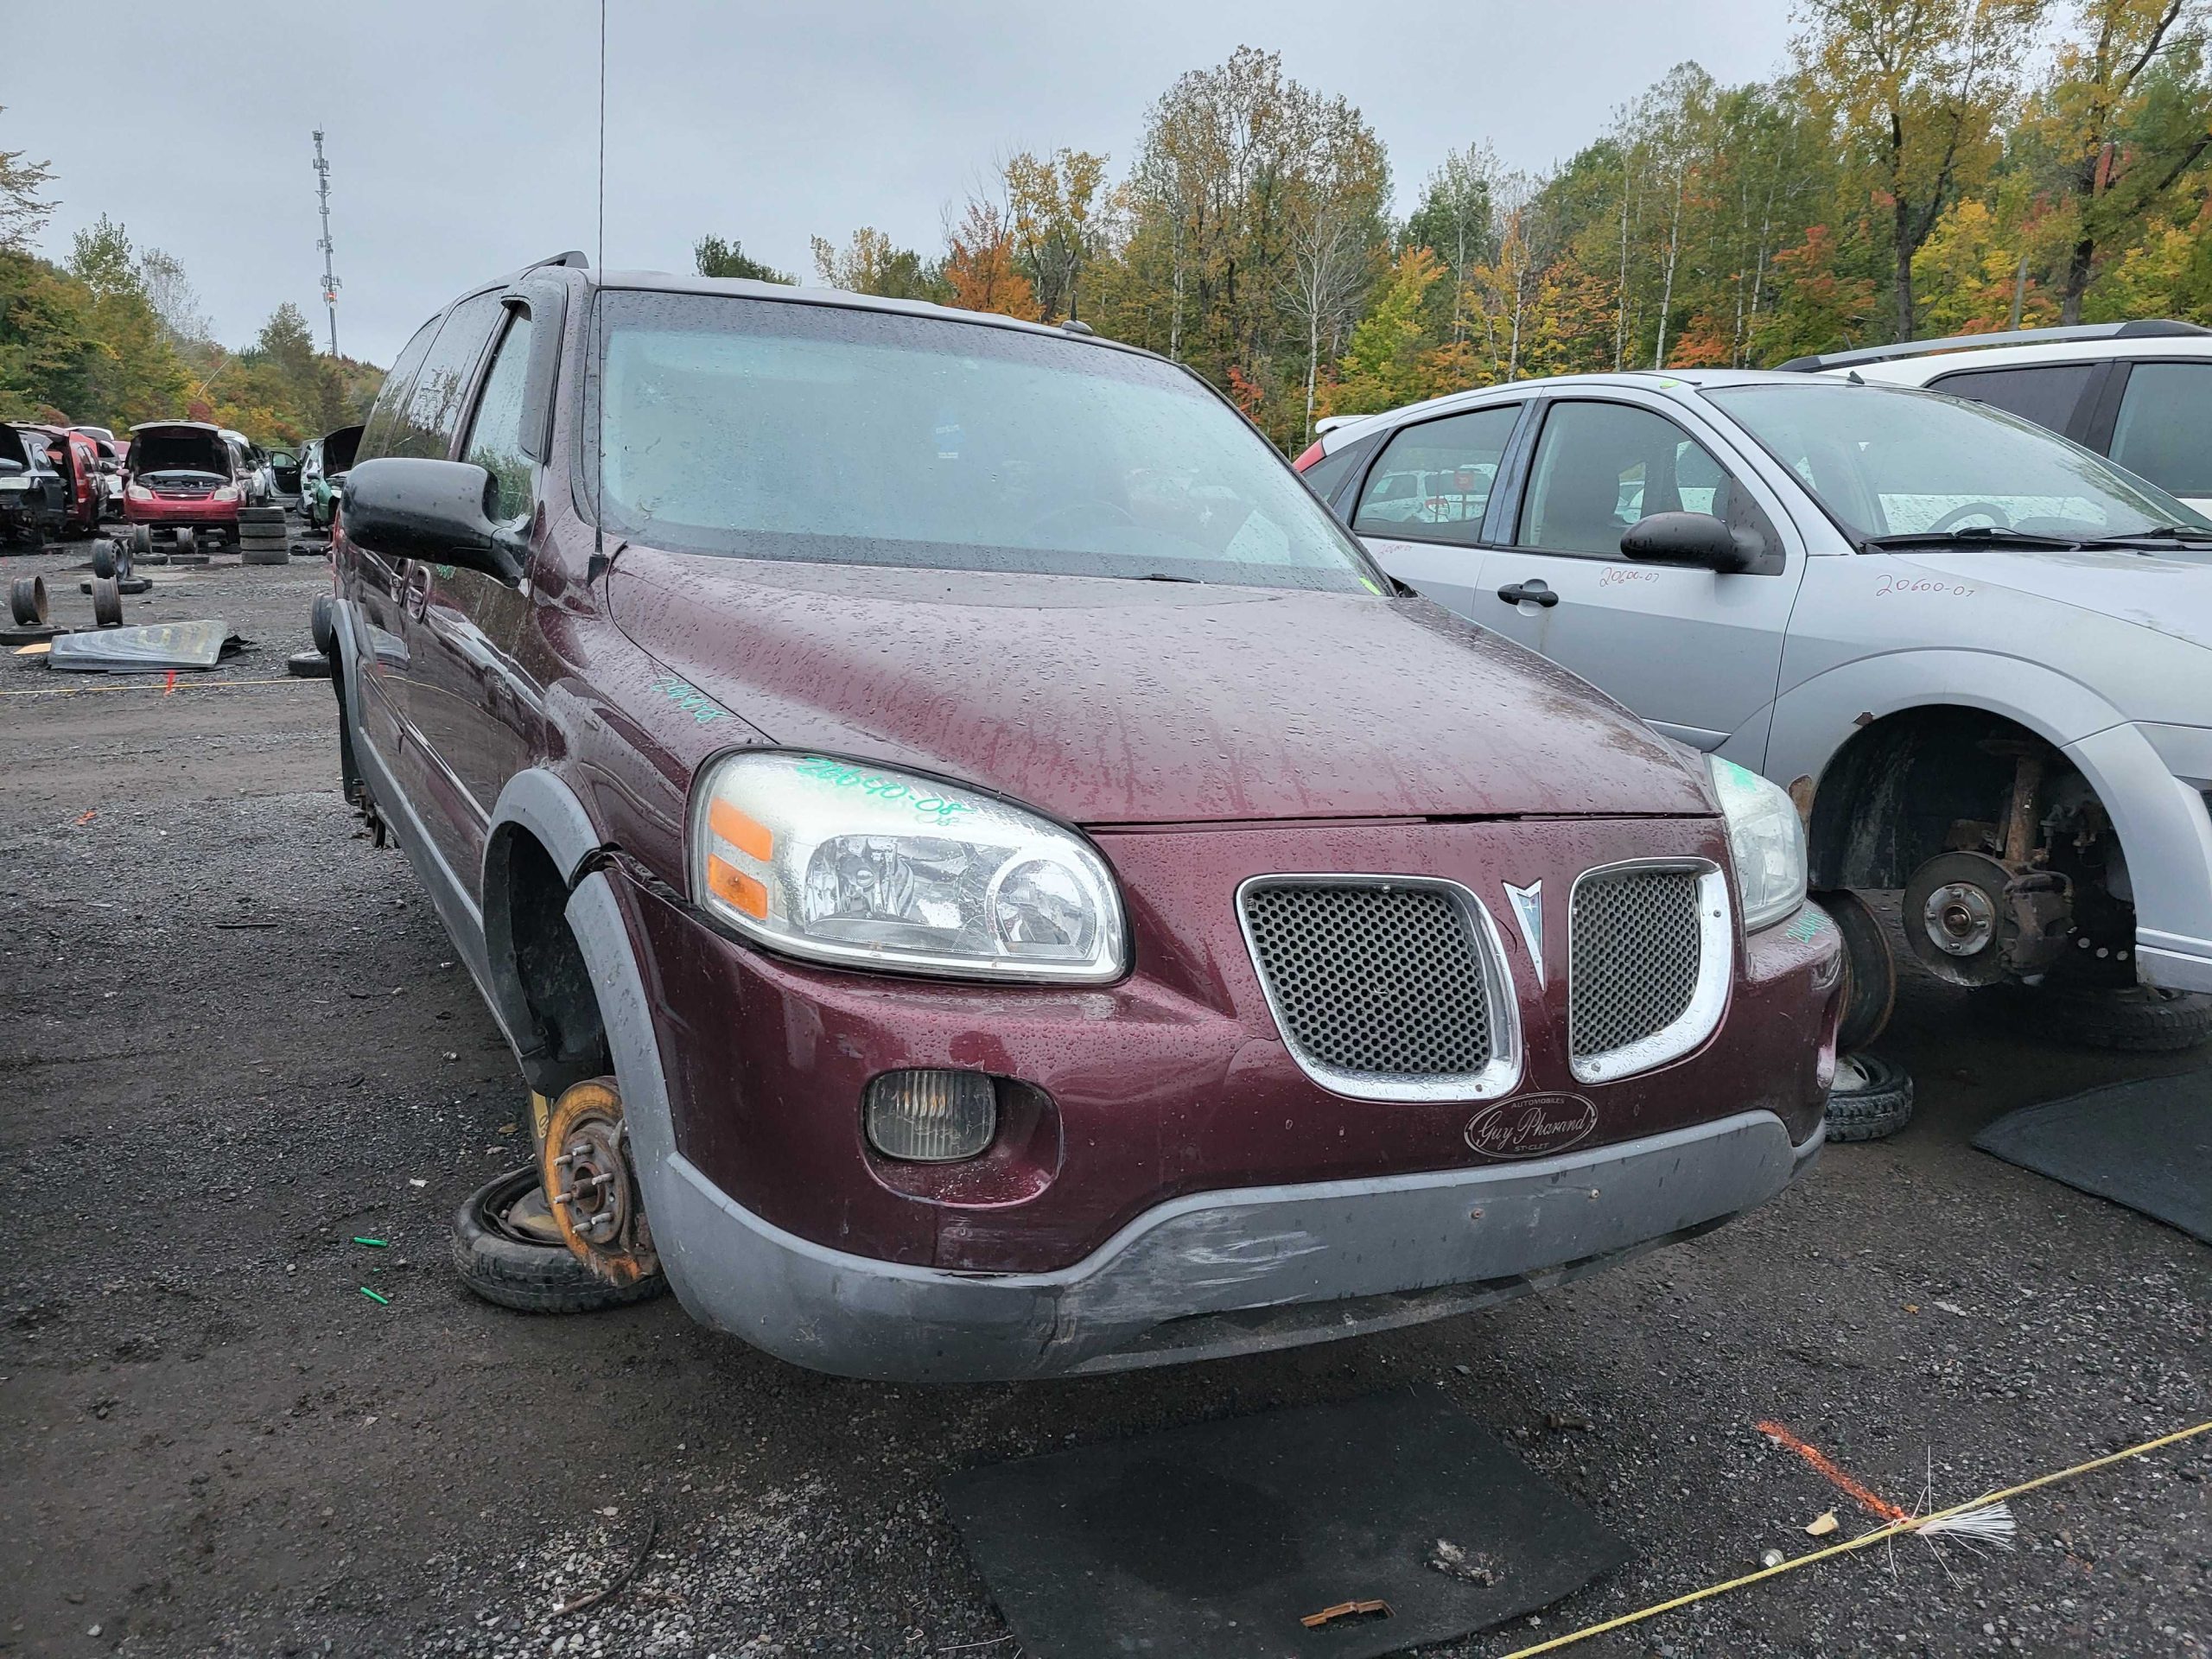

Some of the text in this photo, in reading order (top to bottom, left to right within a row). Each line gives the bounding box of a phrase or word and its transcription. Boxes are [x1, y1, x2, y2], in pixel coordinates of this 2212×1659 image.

[1876, 574, 1975, 597] 20600-07
[1511, 1097, 1566, 1109] AUTOMOBILES
[1477, 1106, 1591, 1151] Guy Pharand
